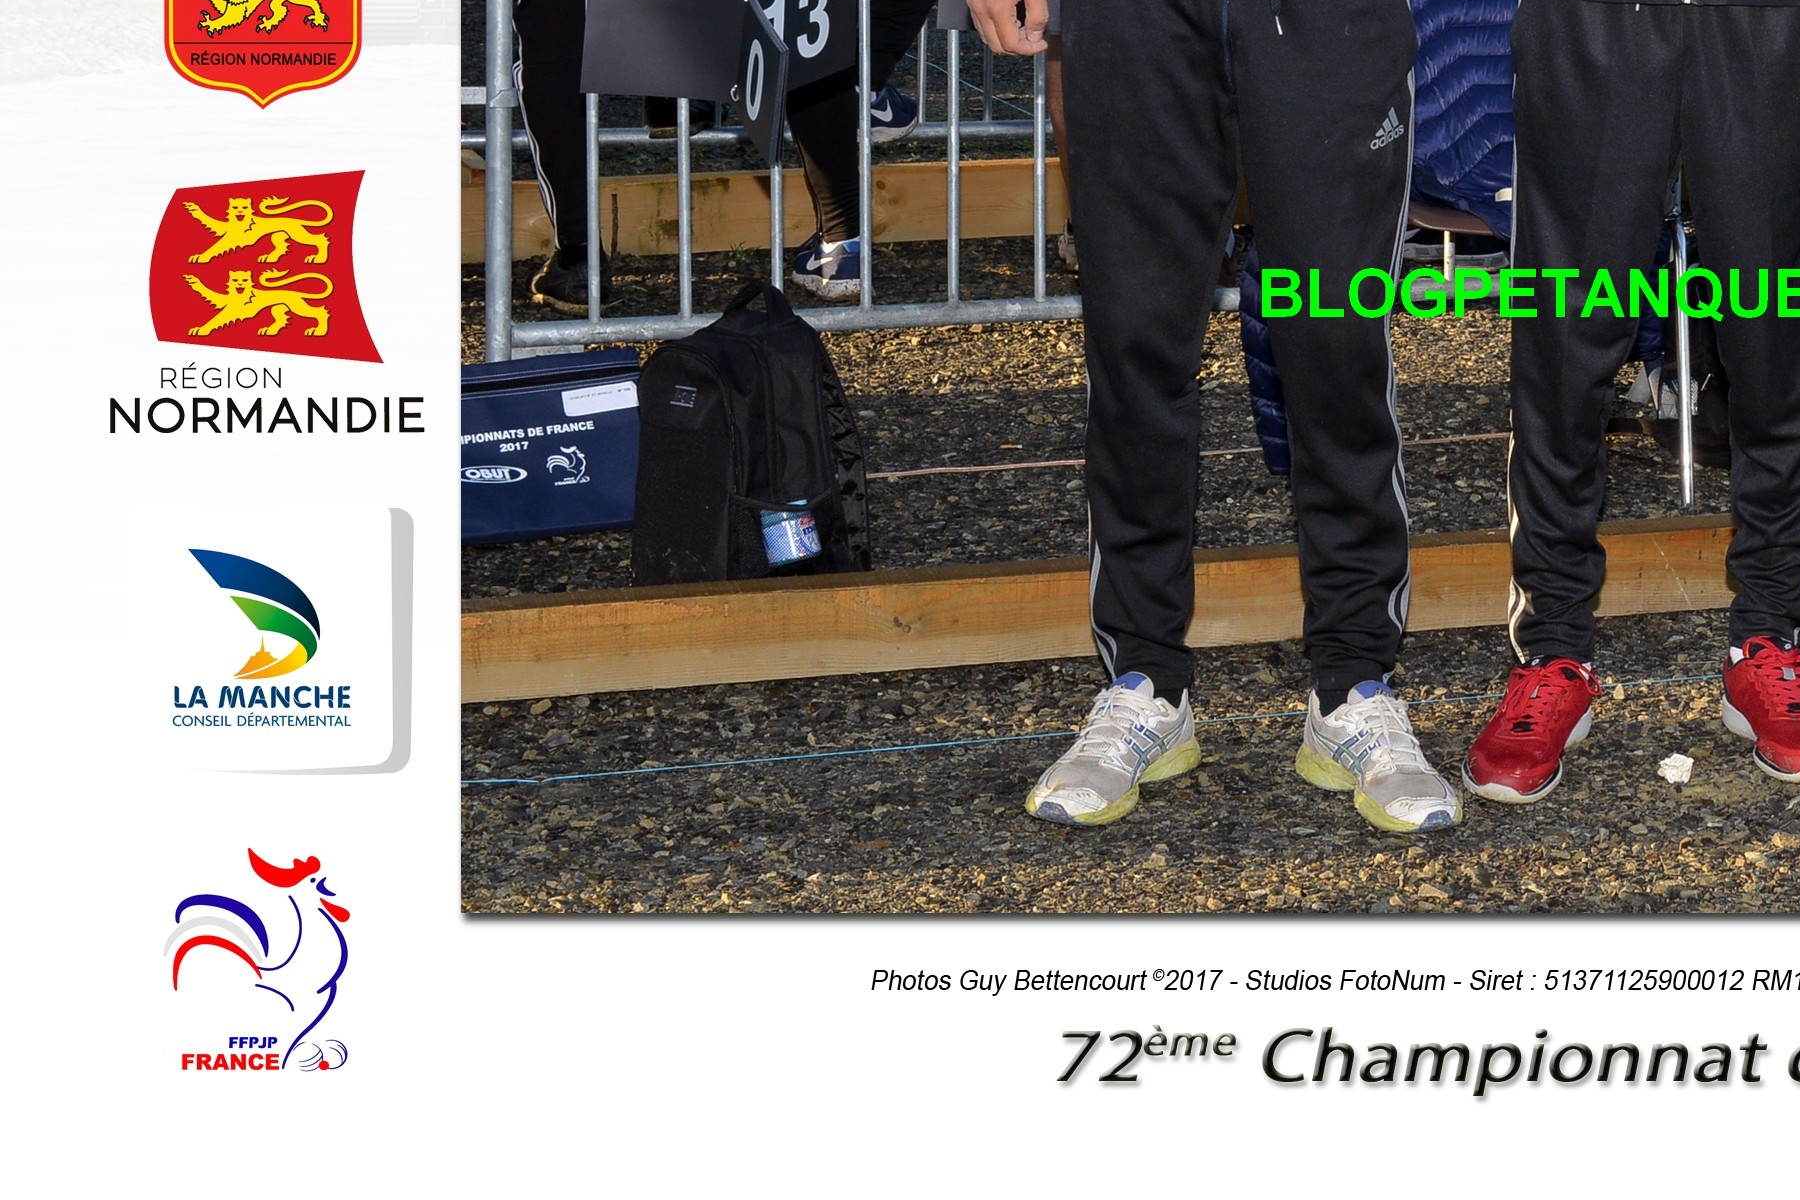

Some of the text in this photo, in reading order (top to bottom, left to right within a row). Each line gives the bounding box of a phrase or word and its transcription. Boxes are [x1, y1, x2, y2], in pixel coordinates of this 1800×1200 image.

[744, 38, 765, 122] 0
[1370, 124, 1405, 151] adidas
[528, 426, 544, 437] DE
[546, 420, 595, 436] FRANCE
[499, 441, 530, 453] 2017
[465, 468, 511, 481] OBUT
